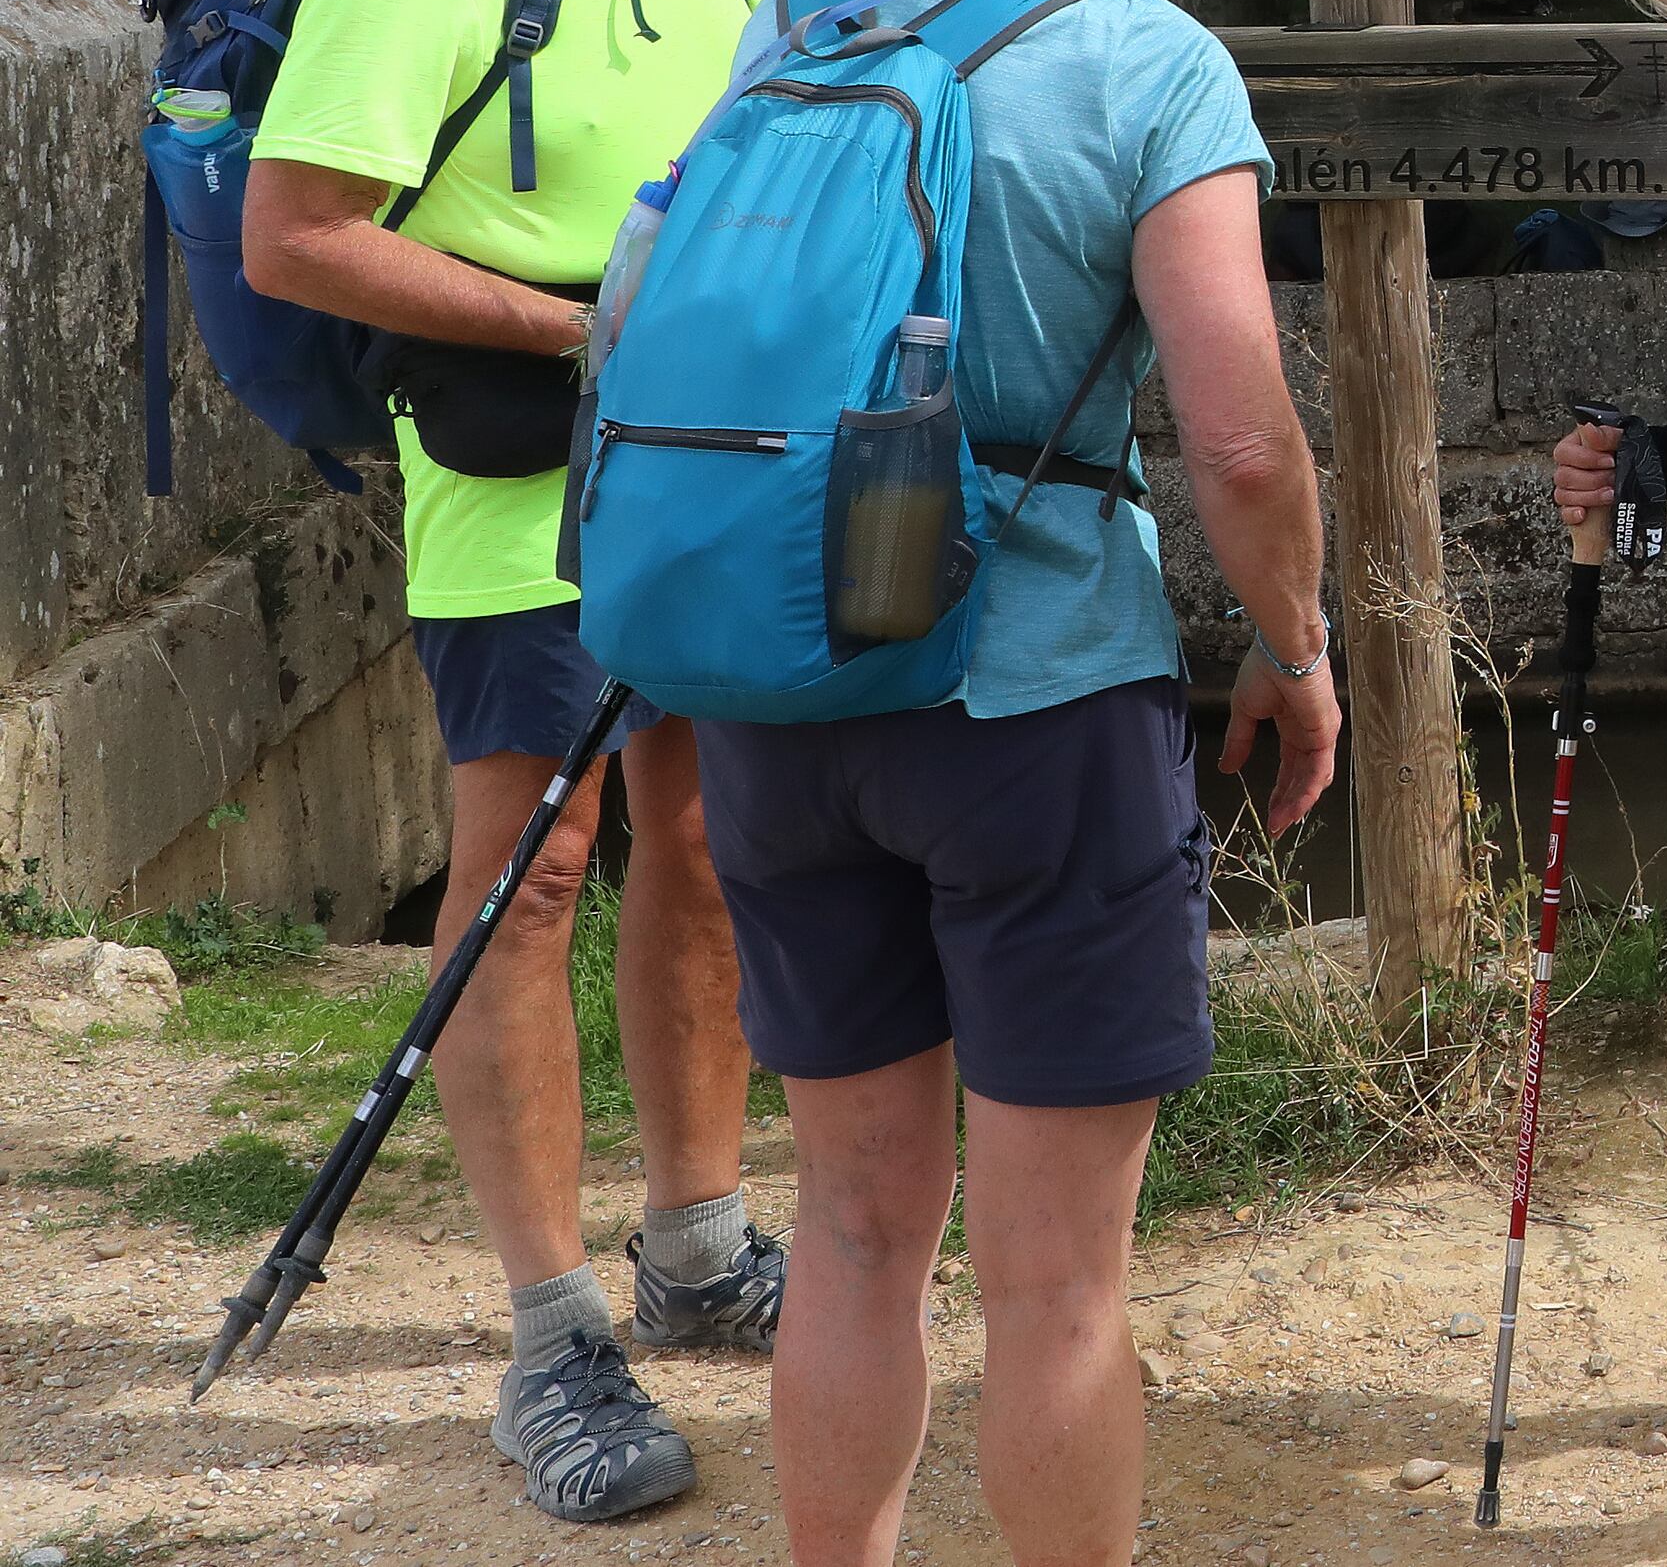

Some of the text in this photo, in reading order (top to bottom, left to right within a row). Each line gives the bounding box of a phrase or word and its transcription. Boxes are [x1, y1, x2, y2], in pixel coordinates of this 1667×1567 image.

[1390, 146, 1545, 193] 4.478
[1564, 149, 1664, 193] km.
[1623, 503, 1636, 555] PRODUCTS
[1514, 1085, 1536, 1207] CARBON CORK
